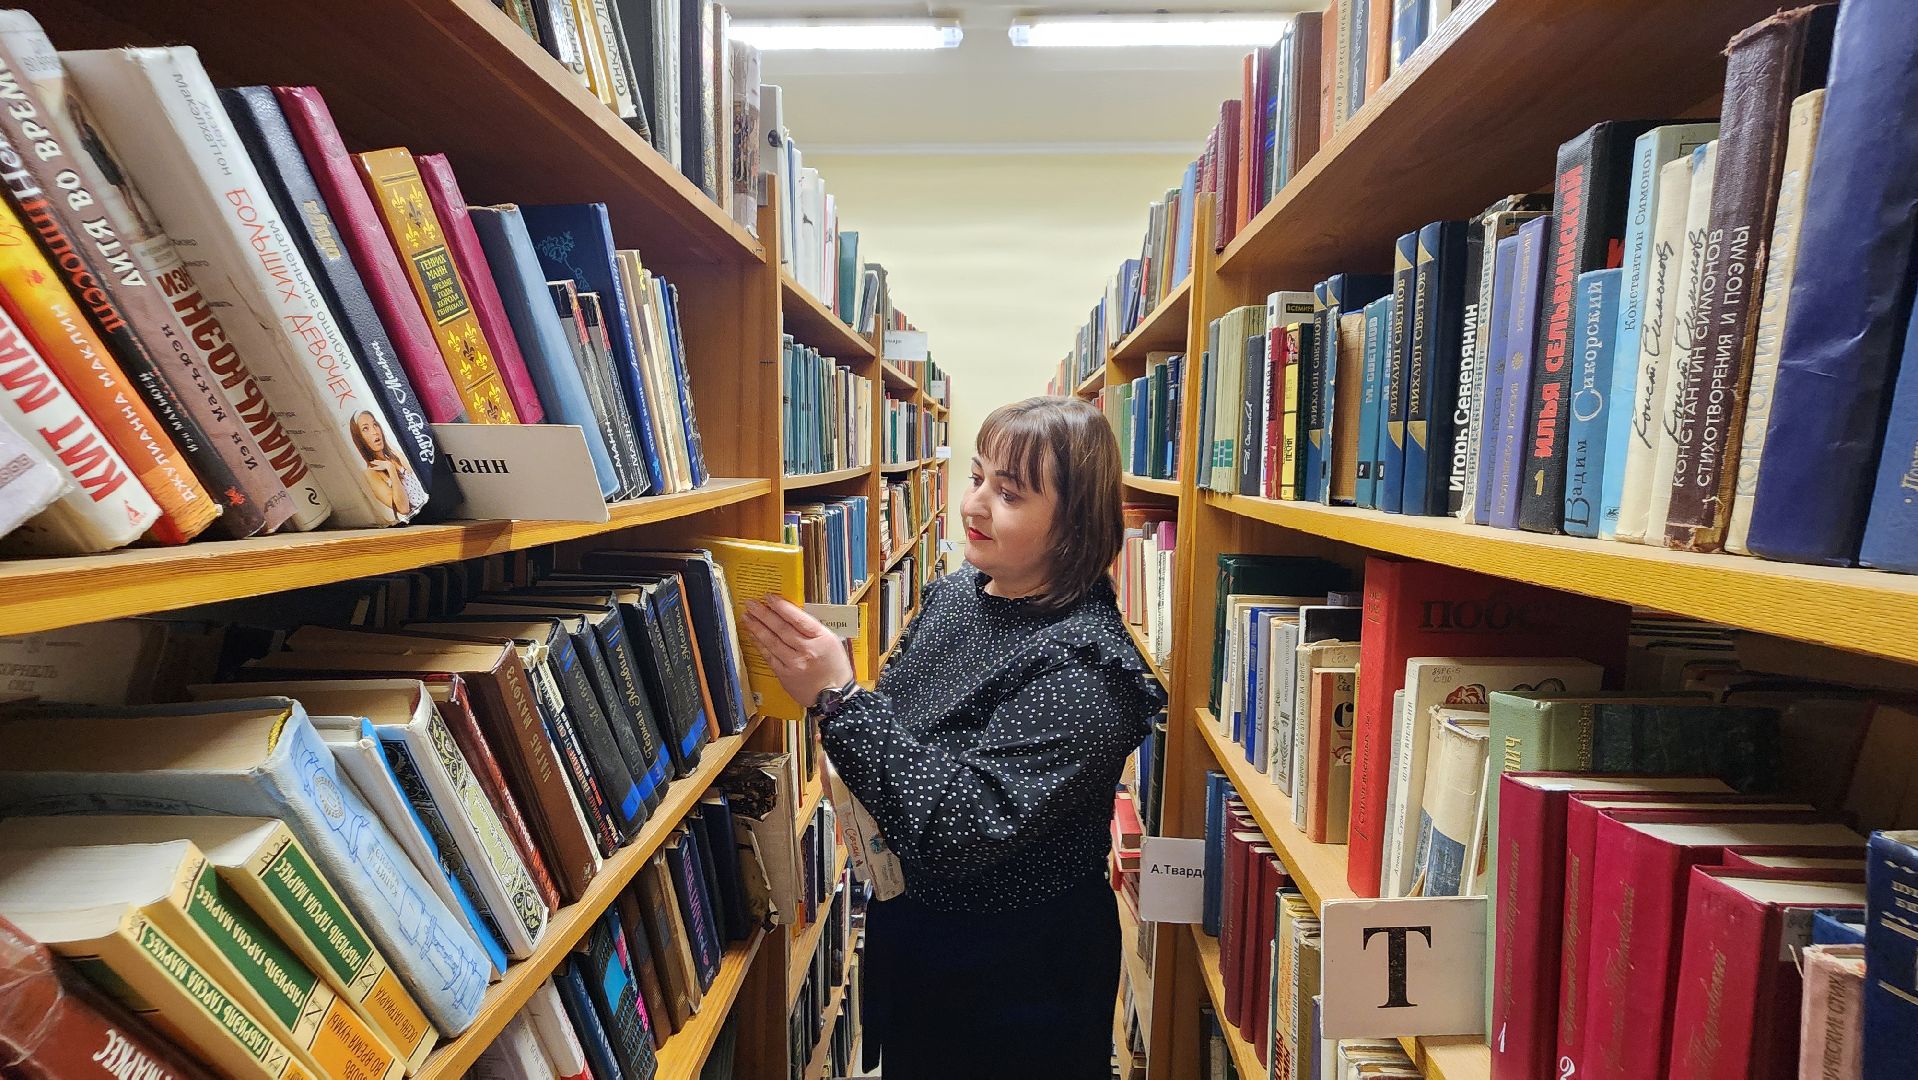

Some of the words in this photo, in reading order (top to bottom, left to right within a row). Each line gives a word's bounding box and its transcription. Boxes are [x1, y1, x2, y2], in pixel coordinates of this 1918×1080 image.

[173, 72, 233, 177] Макэлхаттон
[56, 168, 94, 211] ВО
[1634, 148, 1652, 227] Симонов
[82, 216, 147, 287] ДИТЯ
[420, 254, 447, 271] ГЕНРИХ
[425, 265, 448, 281] МАНН
[1545, 165, 1583, 373] СЕЛЬВИНСКИЙ
[1607, 238, 1625, 269] И
[1723, 225, 1751, 306] ПОЭМЫ
[156, 266, 197, 297] ИЭН
[223, 187, 303, 303] БОЛЬШИХ
[283, 313, 357, 410] ДЕВОЧЕК
[267, 219, 316, 312] маленькие
[315, 310, 353, 370] ошибки
[431, 278, 454, 293] ЗРЕЛЫЕ
[436, 293, 460, 308] КОРОЛЯ
[437, 286, 454, 299] ГОДЫ
[1414, 271, 1426, 342] СВЕТЛОВ
[1624, 230, 1645, 332] Константин
[1394, 278, 1406, 345] СВЕТЛОВ
[1719, 312, 1734, 326] И
[51, 303, 121, 389] МАКЛИН
[1313, 317, 1322, 369] СВЕТЛОВ
[1367, 316, 1378, 383] СВЕТЛОВ
[1454, 303, 1479, 425] Северянин
[1573, 281, 1604, 422] Сикорский
[1673, 344, 1706, 489] КОНСТАНТИН
[1697, 227, 1724, 343] СИМОНОВ
[161, 322, 226, 422] Макьюэн
[173, 298, 308, 489] МАКЬЮЭН
[1311, 372, 1320, 425] МИХАИЛ
[1389, 348, 1402, 415] МИХАИЛ
[1410, 343, 1422, 415] МИХАИЛ
[1534, 382, 1562, 458] ИЛЬЯ
[1696, 333, 1733, 488] СТИХОТВОРЕНИЯ
[37, 416, 128, 502] КИТ
[114, 391, 198, 502] ДЖУЛИАННА
[231, 431, 258, 471] Иэн
[1449, 427, 1469, 492] Игорь
[1534, 469, 1545, 497] 1
[1565, 438, 1590, 528] Вадим
[674, 606, 691, 661] Мелвилл
[505, 665, 534, 731] МАХФУЗ
[614, 644, 641, 708] Мелвилл
[634, 709, 654, 760] Герман
[1405, 701, 1413, 750] ВРЕМЕНИ
[530, 733, 553, 784] НАГИБ
[565, 748, 591, 794] ЕВАНГЕЛИЕ
[1402, 750, 1410, 783] ШАГИ
[272, 855, 309, 899] МАРКЕС
[1151, 863, 1205, 879] А.Твард
[1394, 835, 1402, 875] Алексей
[196, 883, 236, 932] МАРКЕС
[298, 888, 336, 936] ГАРСИА
[146, 930, 192, 980] МАРКЕС
[231, 919, 267, 966] ГАРСИА
[325, 920, 365, 973] ГАБРИЭЛЬ
[1362, 925, 1432, 1009] Т
[184, 969, 226, 1018] ГАРСИА
[264, 955, 306, 1009] ГАБРИЭЛЬ
[375, 986, 403, 1025] ПАТРИАРХА
[223, 1004, 271, 1059] ГАБРИЭЛЬ
[326, 1010, 355, 1041] ЧУМЫ
[400, 1015, 417, 1044] ОСЕНЬ
[1290, 992, 1298, 1044] Василий
[1498, 1022, 1507, 1054] 1
[349, 1034, 375, 1064] ВРЕМЯ
[370, 1056, 386, 1078] ВО
[1559, 1056, 1577, 1080] 2
[1823, 1014, 1845, 1080] ИЧЕСКИЕ
